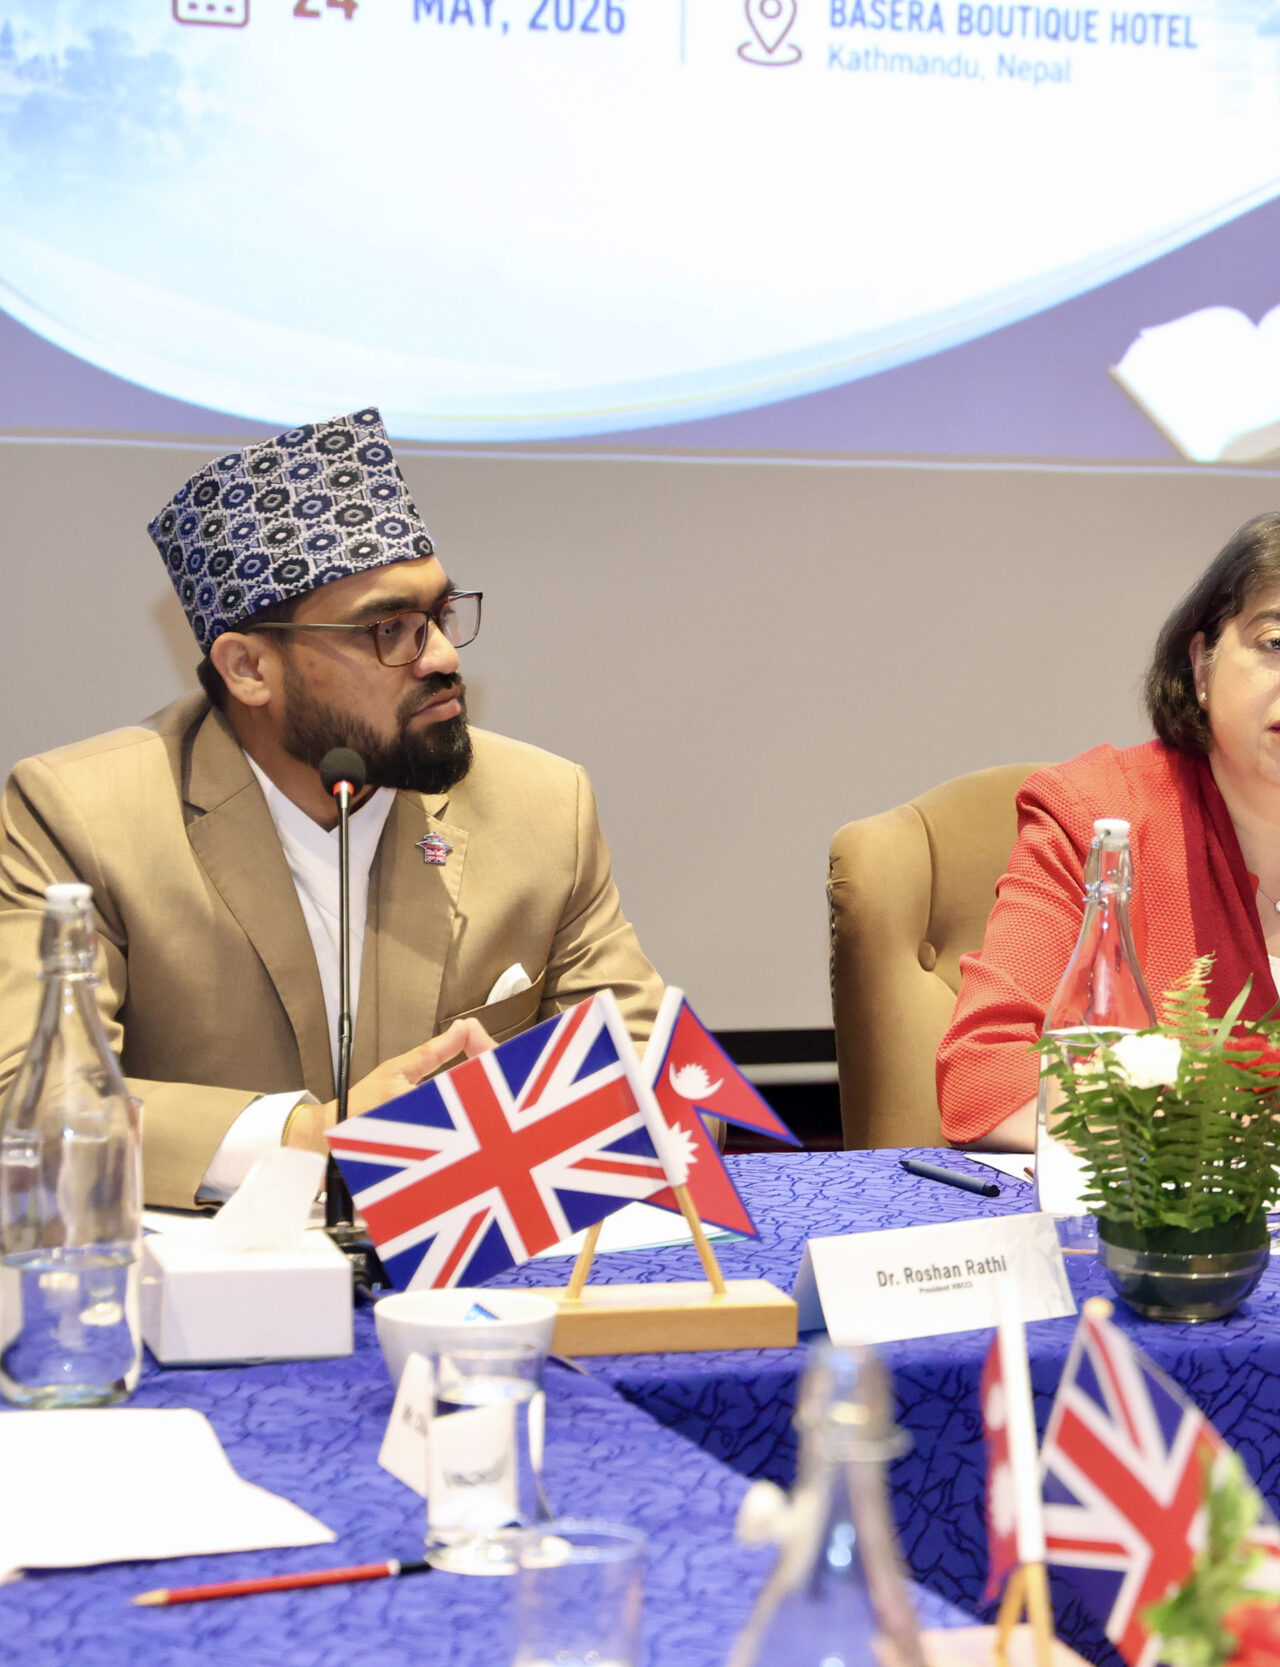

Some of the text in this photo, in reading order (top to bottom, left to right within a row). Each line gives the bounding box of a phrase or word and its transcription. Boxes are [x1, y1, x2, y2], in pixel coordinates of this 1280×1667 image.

[413, 0, 625, 35] MAY, 2026
[829, 0, 1199, 49] BASERA BOUTIQUE HOTEL
[828, 44, 1072, 87] Kathmandu, Nepal
[876, 1255, 1008, 1287] Dr. Roshan Rathi
